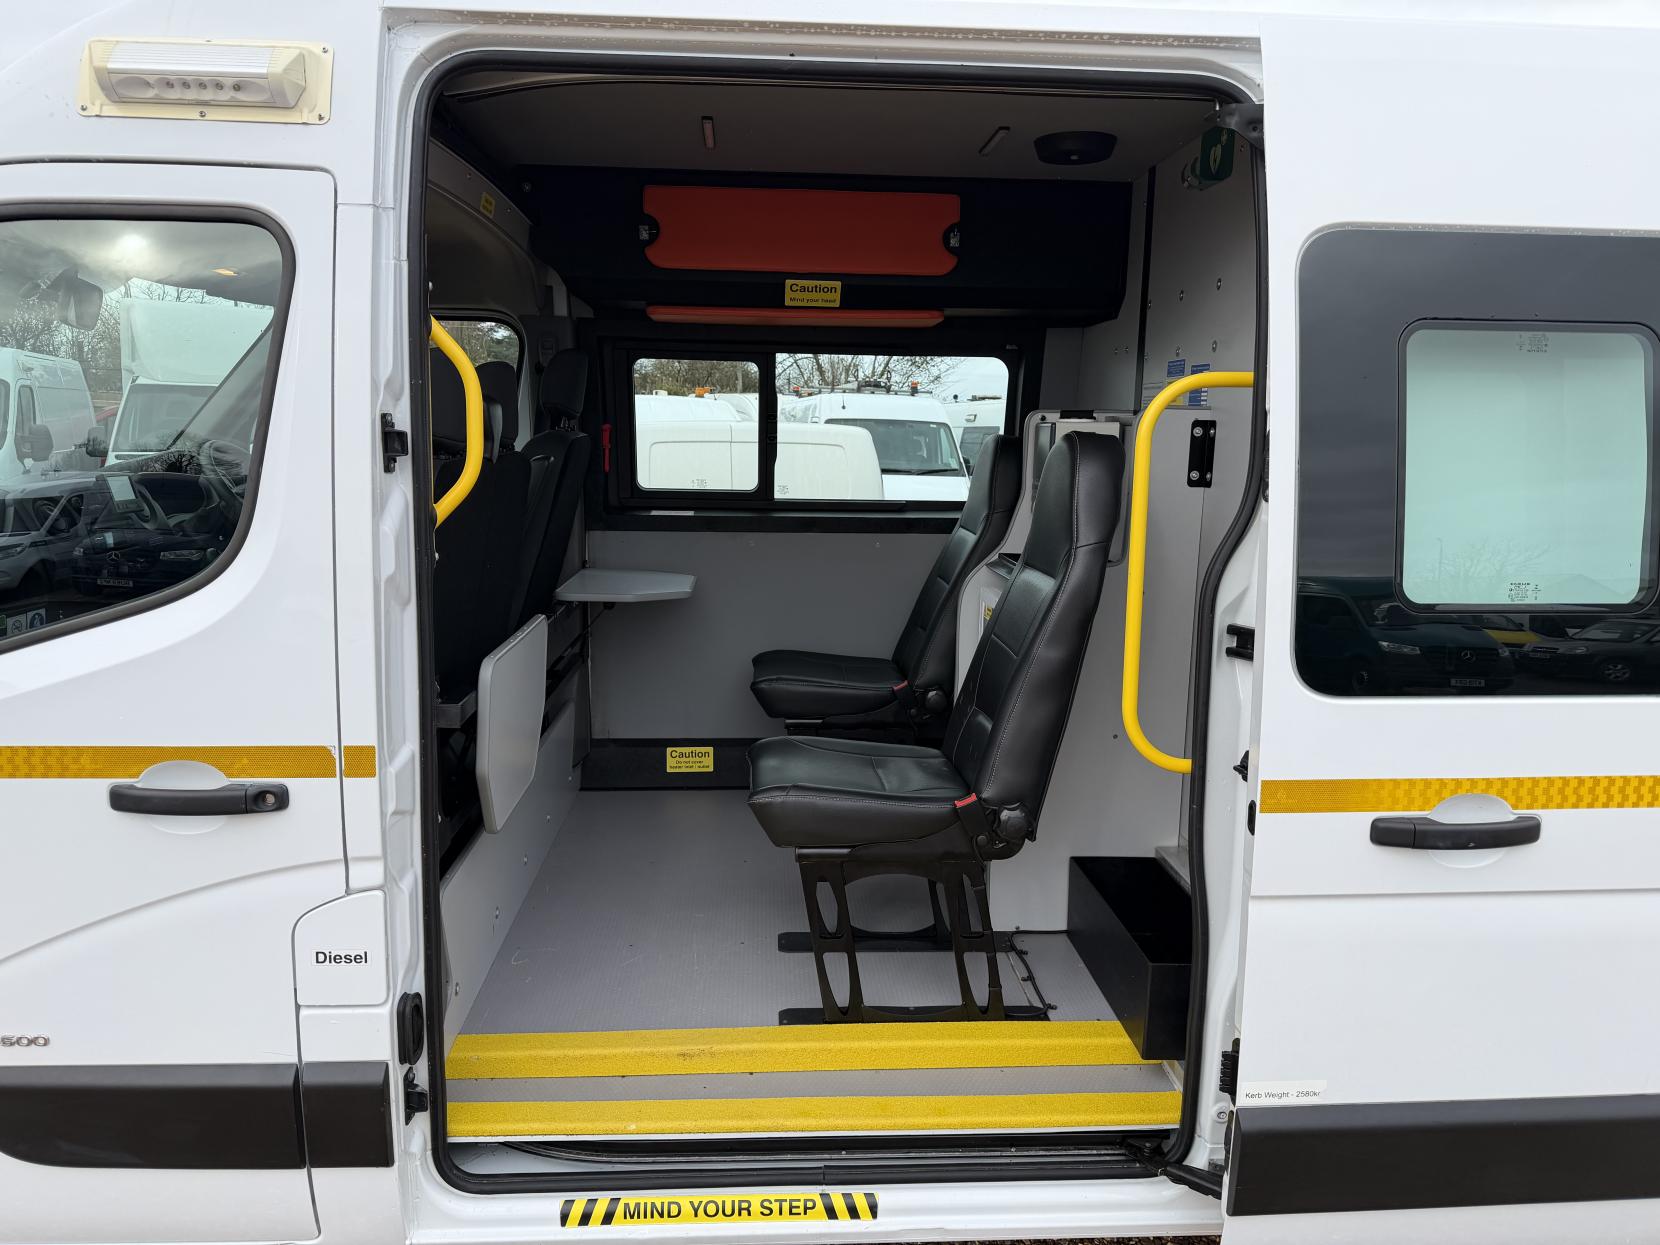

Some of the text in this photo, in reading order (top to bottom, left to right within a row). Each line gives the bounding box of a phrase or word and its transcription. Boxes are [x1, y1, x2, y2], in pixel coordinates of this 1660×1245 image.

[790, 283, 837, 294] Caution
[670, 750, 710, 759] Caution
[315, 951, 368, 964] Diesel
[1245, 1091, 1263, 1099] Kerb
[1264, 1091, 1290, 1099] Weight
[623, 1198, 817, 1220] MIND YOUR STEP
